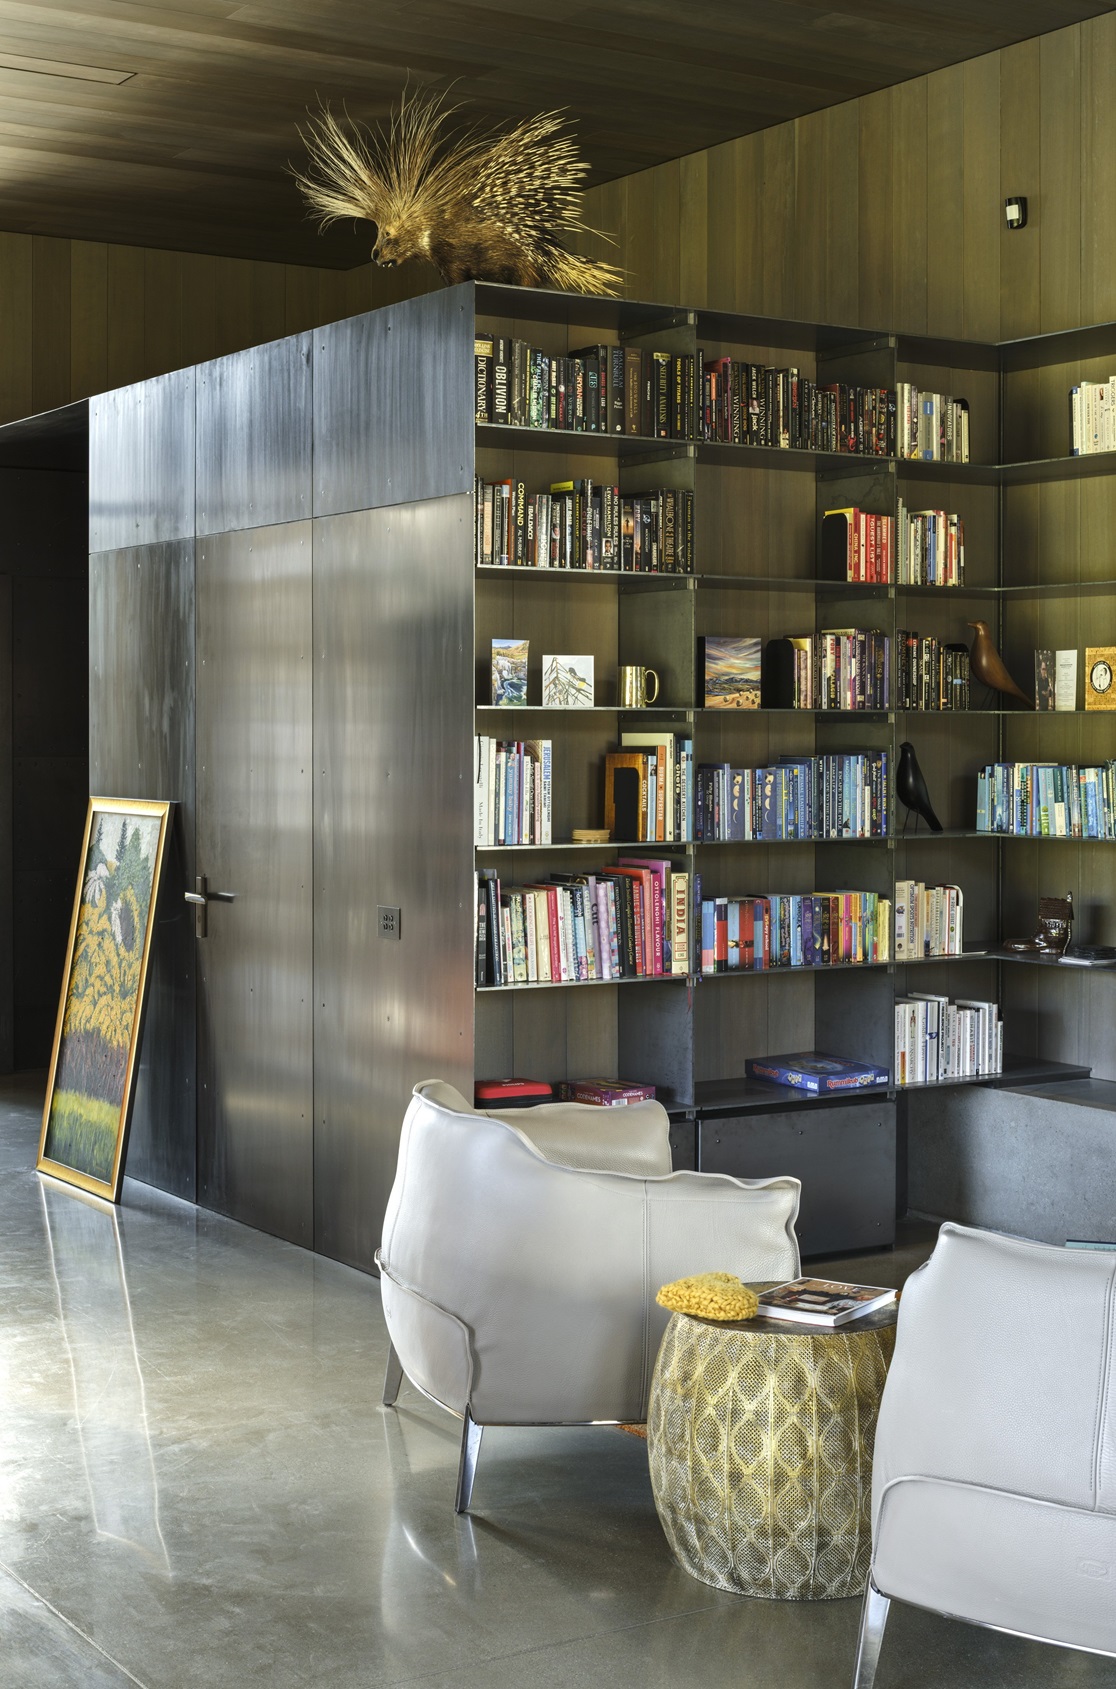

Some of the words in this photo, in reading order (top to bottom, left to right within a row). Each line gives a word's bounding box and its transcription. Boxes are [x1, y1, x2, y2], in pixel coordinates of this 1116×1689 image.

[477, 357, 486, 412] DICTIONARY
[495, 366, 507, 413] OBLIVION
[676, 376, 681, 384] OF
[659, 395, 667, 423] ANALYSIS
[517, 483, 525, 526] COMMAND
[613, 496, 618, 505] NO
[666, 498, 674, 531] WHALEBONE
[666, 537, 674, 555] THEATRE
[543, 746, 551, 780] JERUSALEM
[676, 889, 685, 936] INDIA
[753, 1064, 779, 1077] Rummikub
[827, 1077, 858, 1089] Rummikub
[576, 1093, 601, 1103] CODENAMES
